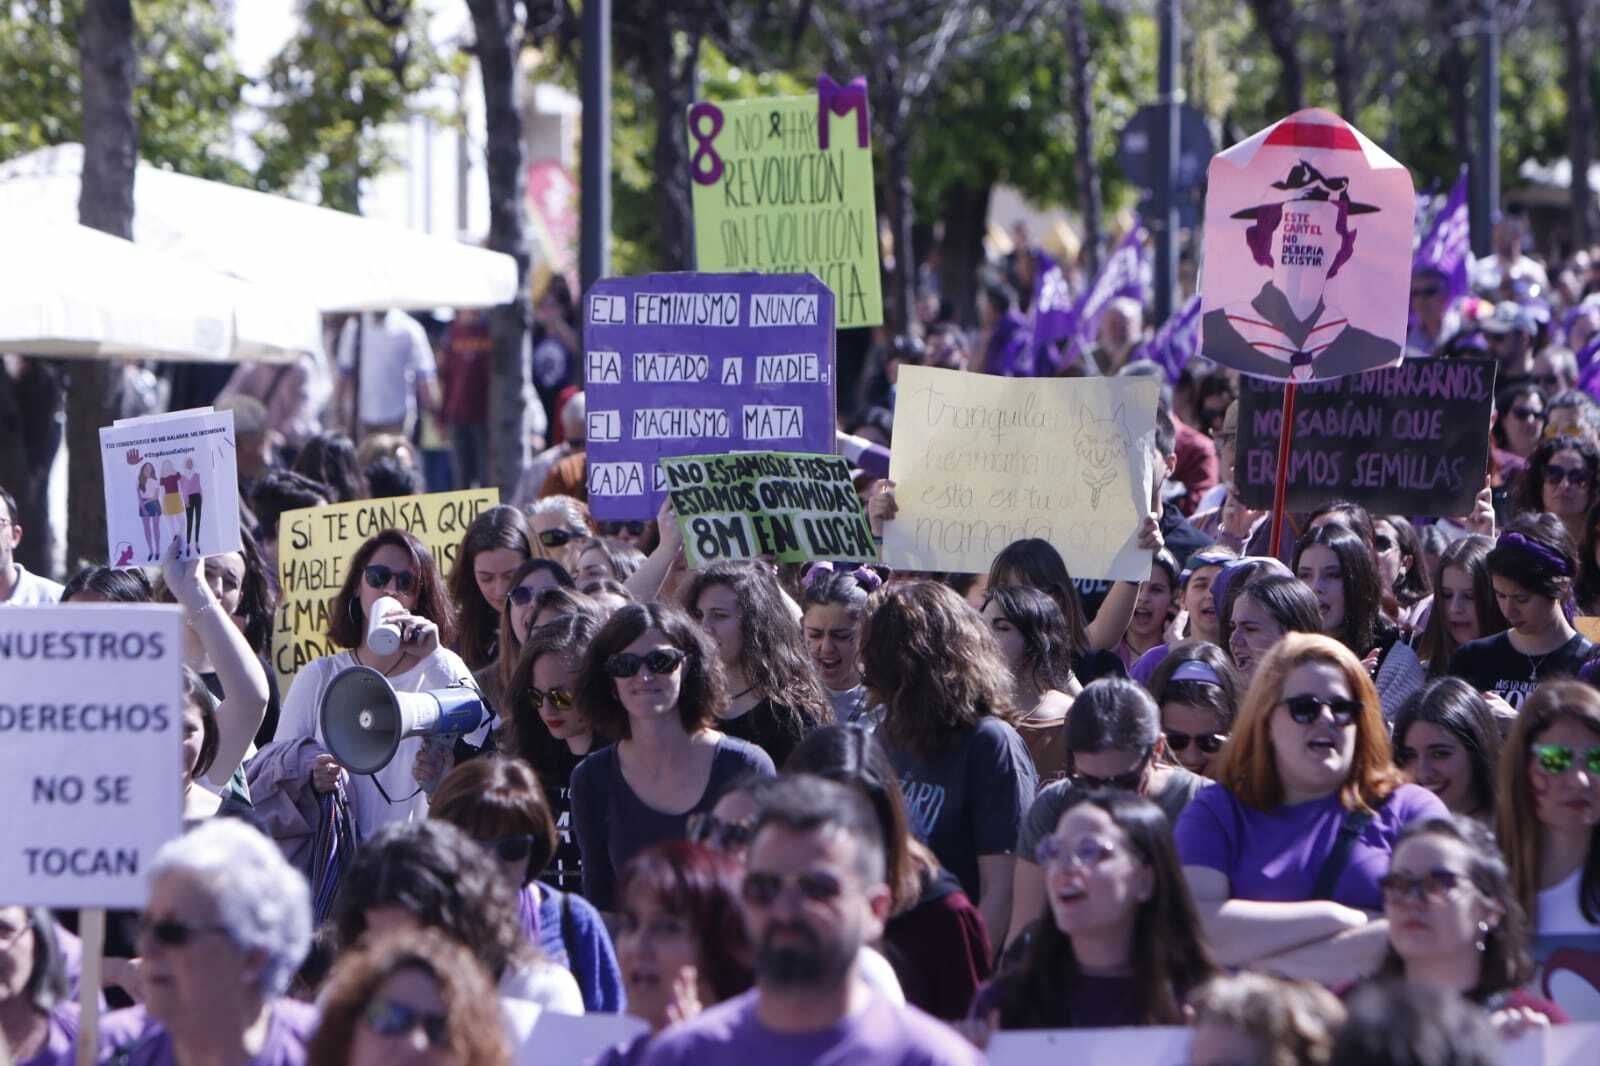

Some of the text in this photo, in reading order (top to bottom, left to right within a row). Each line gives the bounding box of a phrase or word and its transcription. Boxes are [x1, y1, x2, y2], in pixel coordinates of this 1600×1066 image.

[688, 72, 869, 186] 8 M
[734, 112, 764, 151] NO
[1283, 223, 1323, 236] CARTEL
[1284, 212, 1310, 223] ESTE
[1282, 234, 1298, 244] NO
[1281, 255, 1322, 267] EXISTIR
[590, 293, 817, 325] EL FEMINISMO NUNCA
[588, 353, 622, 382] HA
[634, 355, 709, 382] MATADO
[724, 359, 740, 384] A
[589, 406, 803, 441] EL MACHISMO MATA
[914, 383, 1047, 445] tranquila
[1253, 408, 1282, 438] NO
[1392, 409, 1444, 440] QUE
[589, 462, 643, 496] CADA
[667, 454, 851, 487] NO ESTAMOS DE FIESTA
[1352, 452, 1466, 491] SEMILLAS
[671, 479, 860, 516] ESTAMOS OPRIMIDAS
[322, 512, 350, 543] TE
[356, 500, 428, 538] CANSA
[692, 514, 876, 560] 8M EN LUCHA
[282, 556, 343, 592] HABLE
[0, 703, 170, 733] DERECHOS
[33, 775, 131, 804] NO SE
[26, 848, 139, 877] TOCAN
